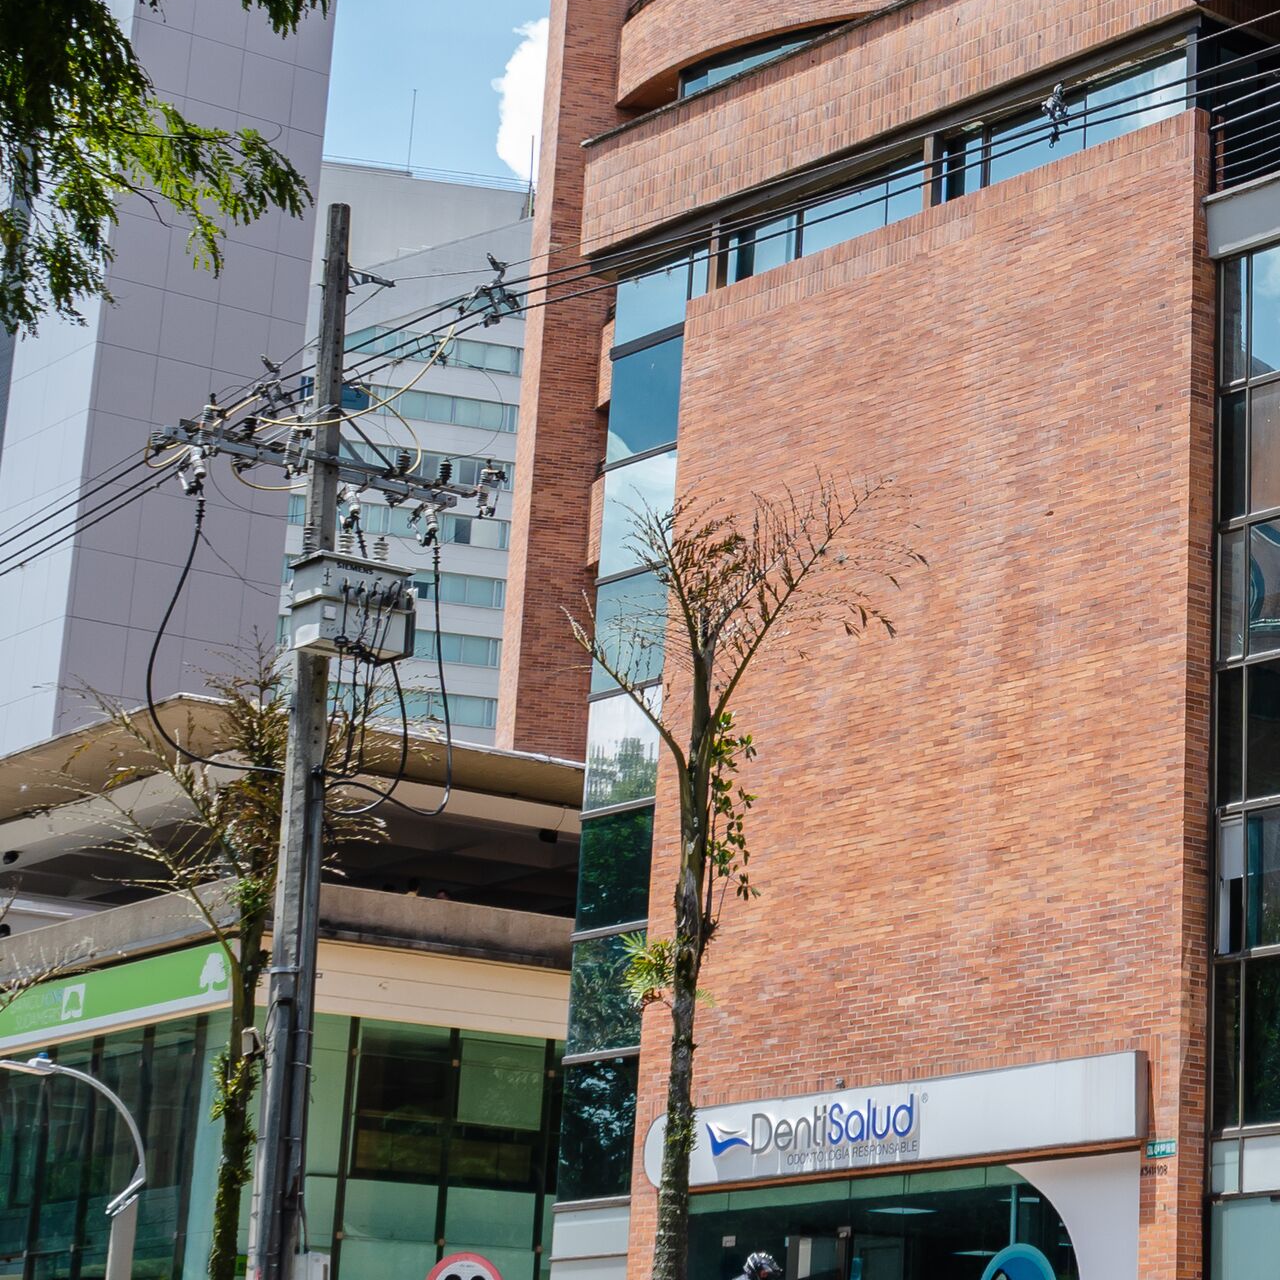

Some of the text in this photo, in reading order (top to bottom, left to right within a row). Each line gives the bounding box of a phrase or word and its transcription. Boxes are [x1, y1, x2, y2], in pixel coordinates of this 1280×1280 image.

[336, 561, 374, 575] SIEMENS
[751, 1093, 914, 1155] DentiSalud
[852, 1139, 918, 1158] RESPONSABLE
